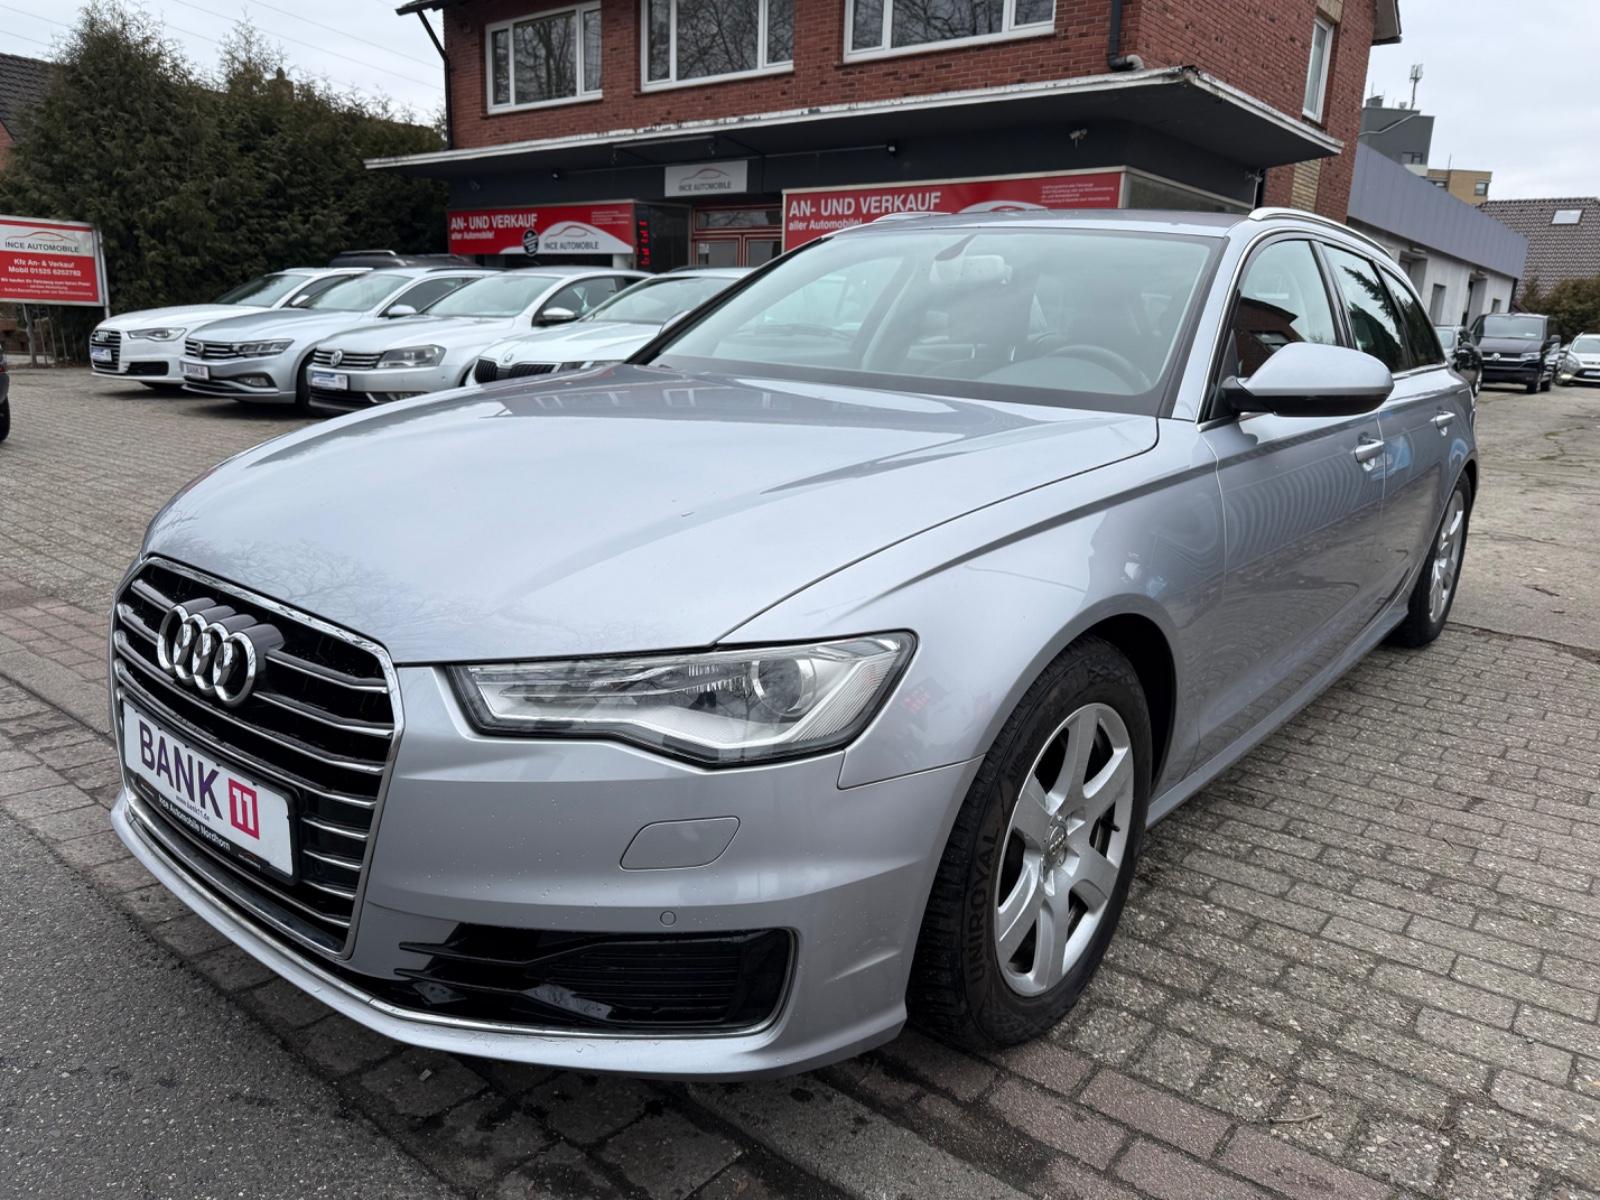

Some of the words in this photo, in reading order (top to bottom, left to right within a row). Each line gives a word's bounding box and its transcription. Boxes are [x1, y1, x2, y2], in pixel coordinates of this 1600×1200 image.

[694, 181, 731, 191] AUTOMOBILE
[789, 200, 816, 217] AN-
[821, 198, 855, 216] UND
[860, 192, 941, 214] VERKAUF
[451, 217, 467, 230] AN-
[469, 215, 489, 229] UND
[491, 213, 538, 228] VERKAUF
[789, 219, 807, 231] aller
[451, 231, 462, 240] aller
[5, 241, 26, 250] INCE
[27, 243, 80, 253] AUTOMOBILE
[560, 240, 599, 250] AUTOMOBILE
[48, 260, 75, 268] Verkauf
[139, 719, 224, 821] BANK
[231, 784, 256, 837] 11
[200, 824, 231, 852] Nordhorn
[969, 827, 1001, 985] UNIROYAL
